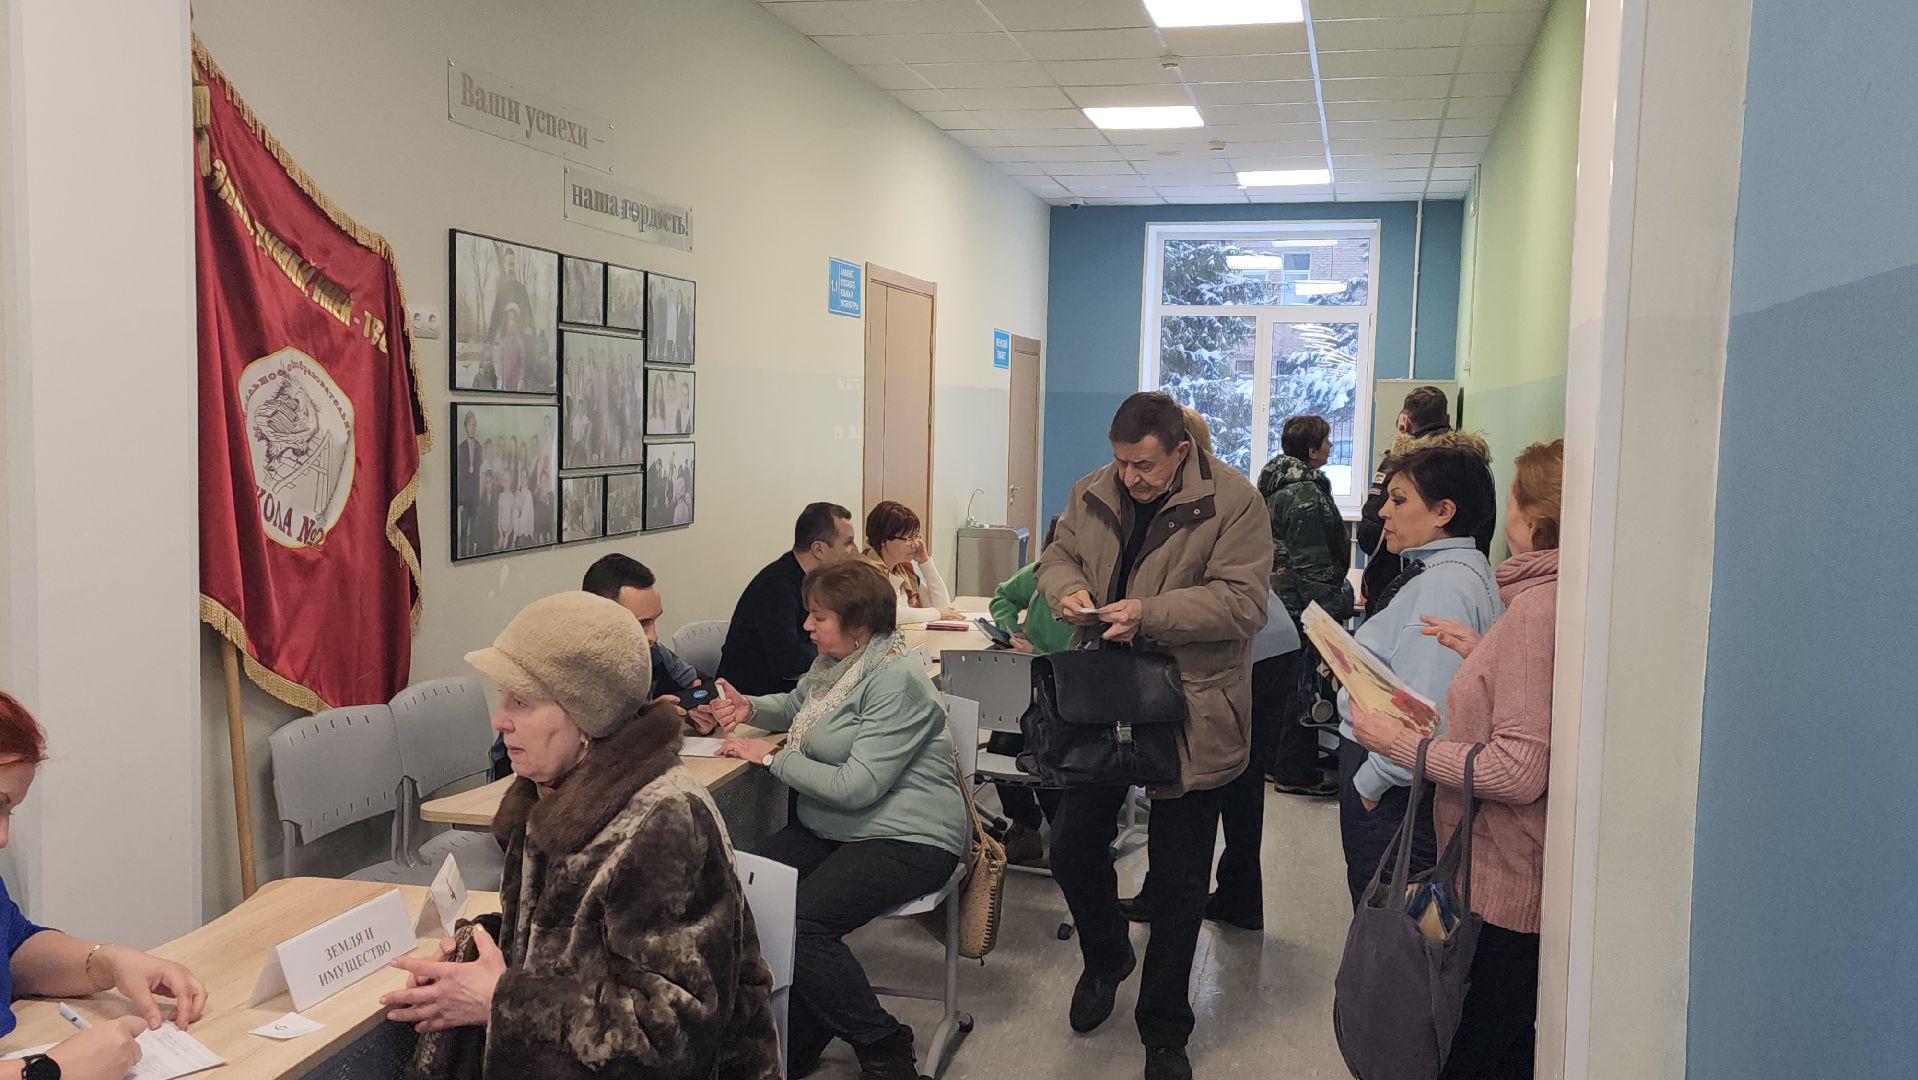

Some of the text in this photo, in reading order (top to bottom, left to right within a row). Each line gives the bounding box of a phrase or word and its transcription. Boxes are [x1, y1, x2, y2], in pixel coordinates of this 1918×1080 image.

[460, 72, 521, 125] Ваши
[525, 104, 589, 149] успехи
[571, 183, 689, 236] наша гордость!
[318, 940, 392, 987] ИМУЩЕСТВО
[324, 927, 375, 961] ЗЕМЛЯ И
